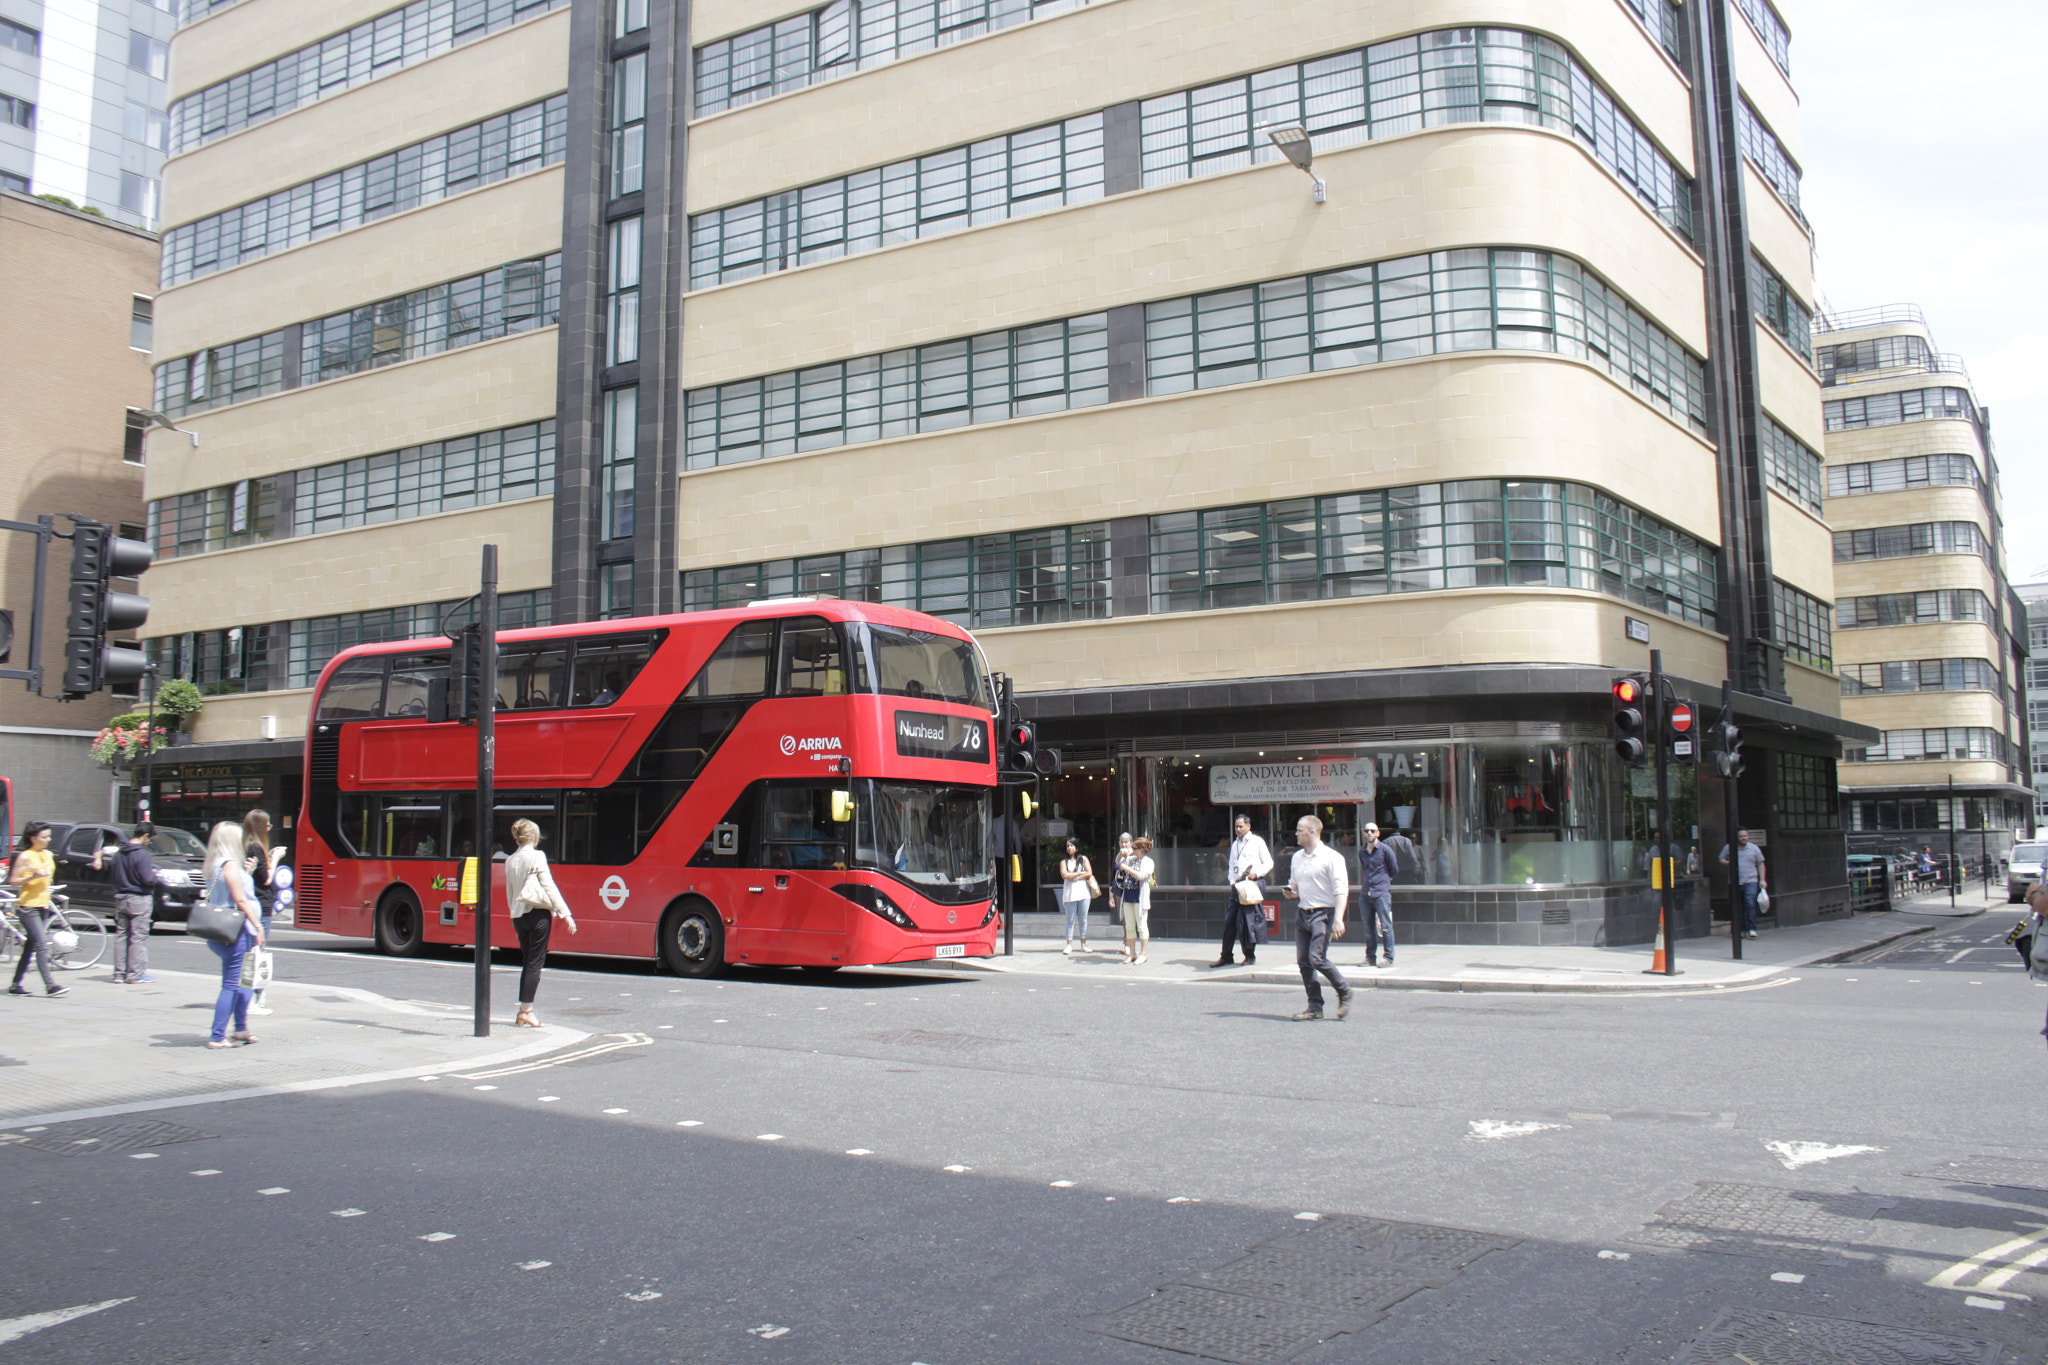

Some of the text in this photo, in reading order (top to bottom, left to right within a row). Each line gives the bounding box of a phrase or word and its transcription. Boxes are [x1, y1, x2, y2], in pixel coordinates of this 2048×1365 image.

[899, 719, 981, 750] Nunhead 78
[798, 736, 843, 751] ARRIVA
[828, 764, 839, 772] HA
[1231, 763, 1350, 780] SANDWICH BAR
[1291, 784, 1331, 792] TAKE-AWAY
